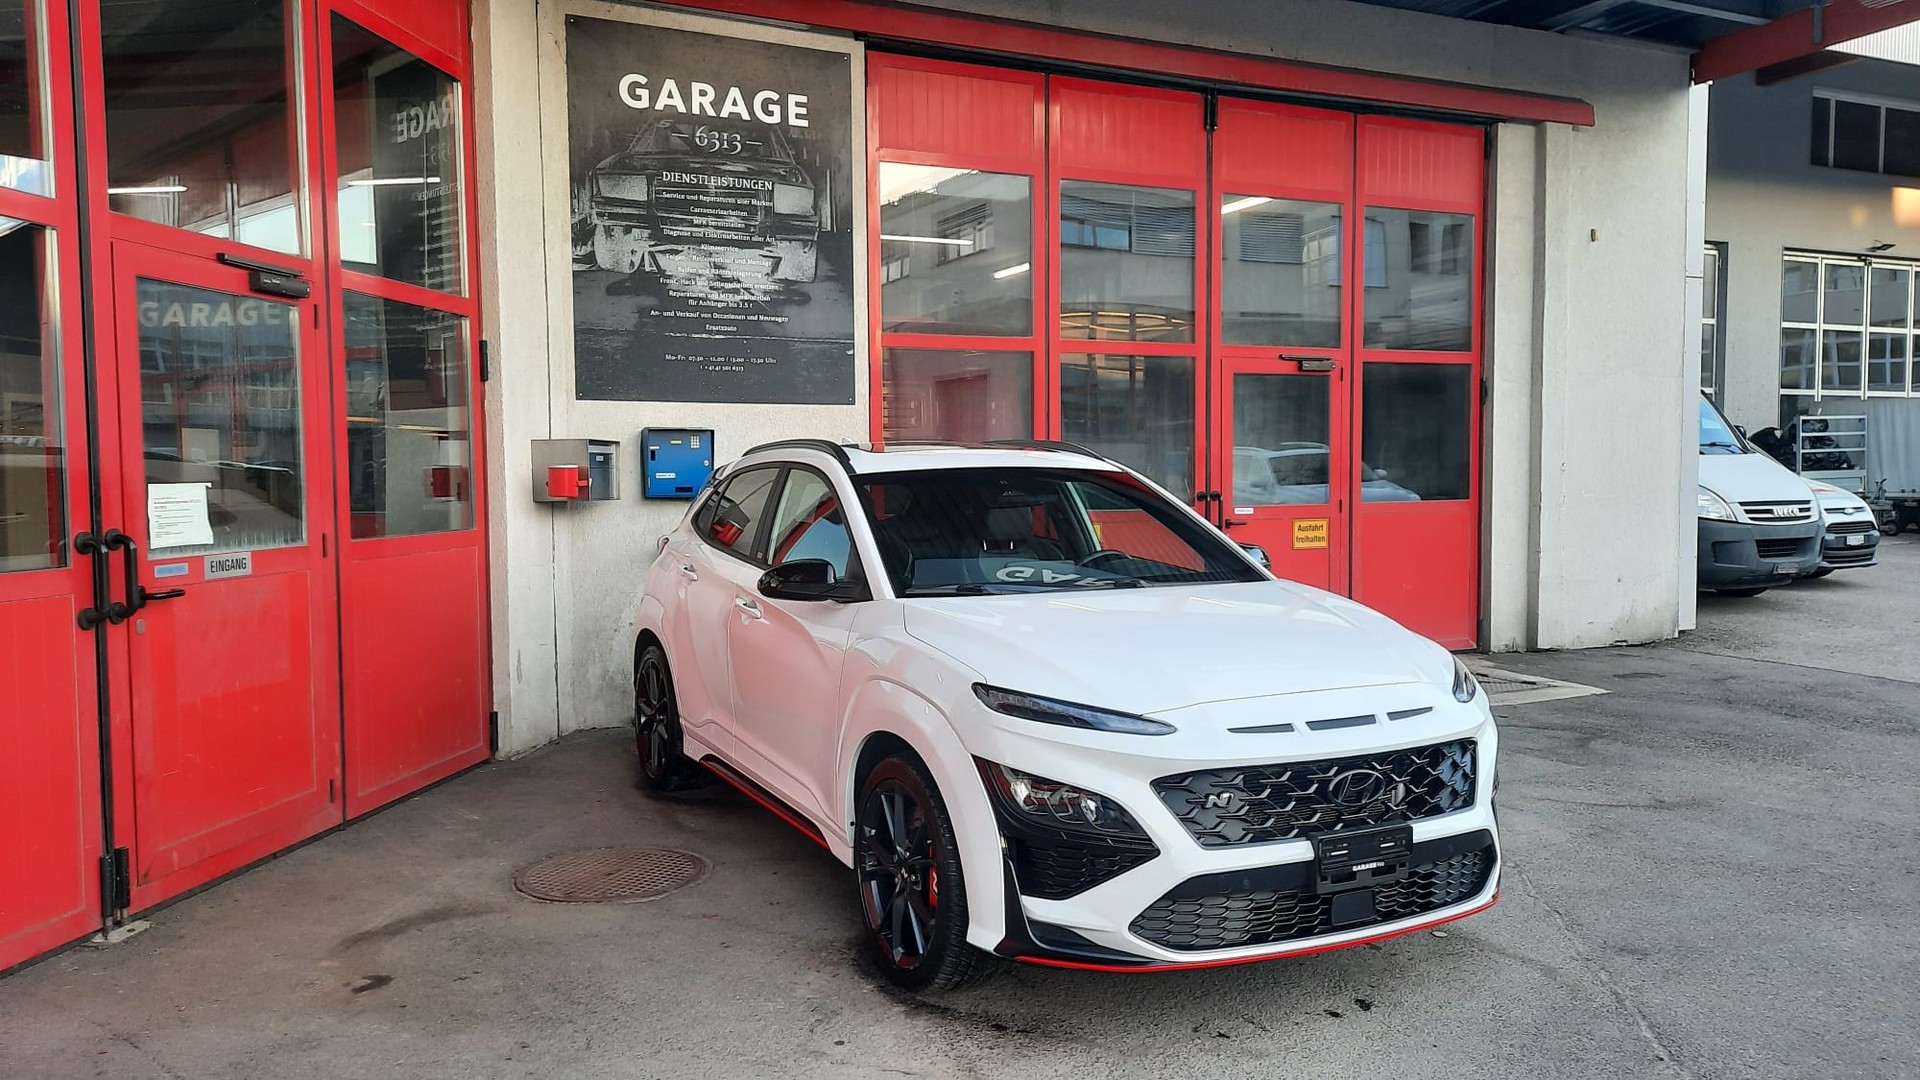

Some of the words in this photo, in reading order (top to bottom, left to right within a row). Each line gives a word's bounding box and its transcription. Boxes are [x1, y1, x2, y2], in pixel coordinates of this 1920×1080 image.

[618, 73, 810, 128] GARAGE
[695, 125, 742, 155] 6313
[662, 171, 773, 190] DIENSTLEISTUNGEN
[662, 192, 685, 200] Service
[699, 195, 736, 204] Reparaturen
[690, 206, 748, 216] Carrosseriearbeiten
[663, 229, 691, 237] Diagnose
[705, 231, 750, 241] Elektroarbeiten
[701, 244, 739, 252] Klimaservice
[669, 290, 706, 299] Reparaturen
[699, 300, 727, 309] Anhänger
[138, 301, 281, 327] GARAGE
[759, 315, 789, 323] Neuwagen
[706, 324, 737, 332] Ersatzauto
[1773, 508, 1800, 517] IVECO
[1298, 524, 1324, 532] Ausfahrt
[1296, 535, 1326, 543] freihalten
[210, 557, 247, 573] EINGANG
